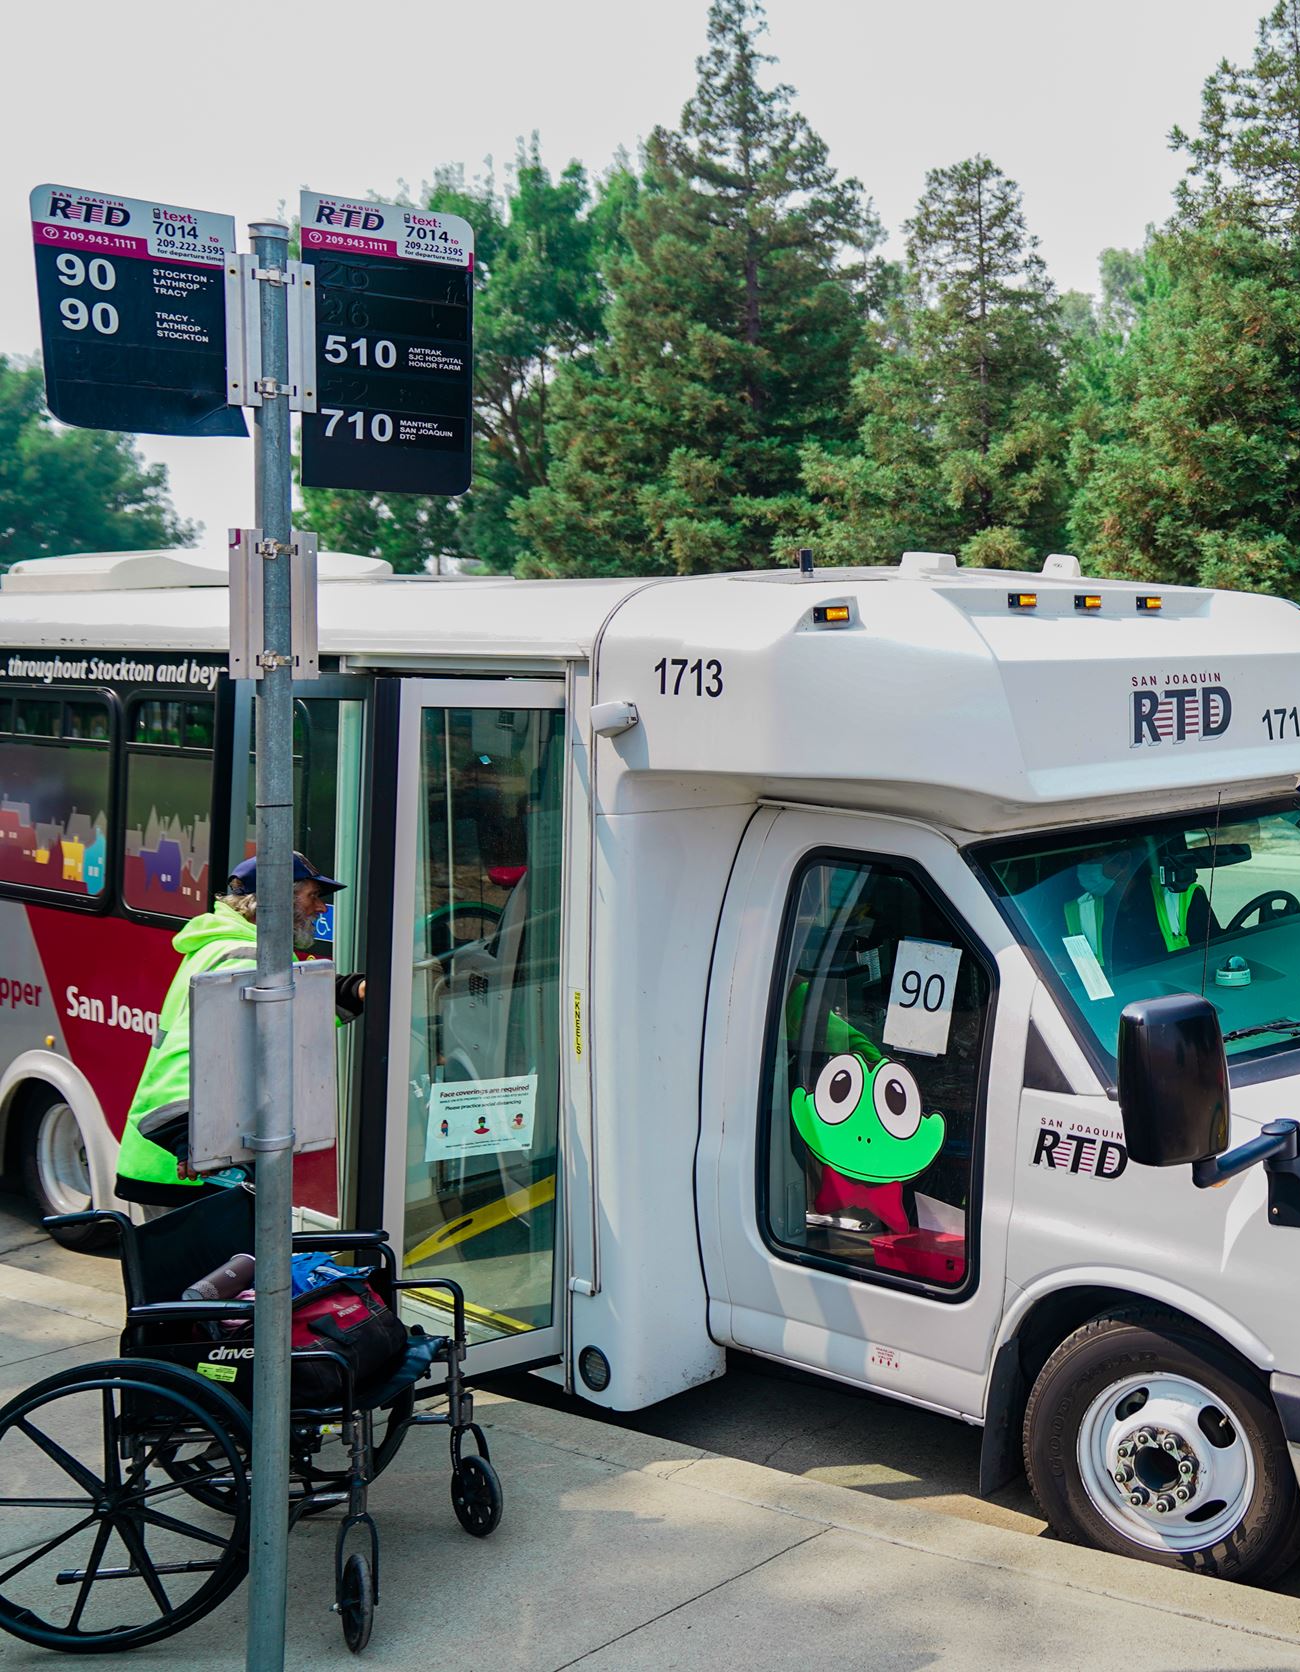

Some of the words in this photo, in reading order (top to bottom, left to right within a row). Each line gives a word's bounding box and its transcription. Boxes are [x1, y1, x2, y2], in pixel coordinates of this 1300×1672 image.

[51, 190, 73, 199] SAN
[79, 195, 125, 208] JOAQUIN
[318, 199, 337, 207] SAN
[341, 203, 380, 213] JOAQUIN
[48, 196, 131, 227] RTD
[163, 209, 198, 225] text:
[314, 204, 384, 231] RTD
[411, 214, 442, 228] text:
[63, 230, 137, 250] 209.943.1111
[152, 220, 199, 240] 7014
[209, 235, 220, 244] to
[405, 225, 449, 243] 7014
[156, 238, 225, 256] 209.222.3595
[325, 234, 388, 252] 209.943.1111
[404, 240, 463, 256] 209.222.3595
[169, 250, 206, 261] departure
[404, 249, 415, 257] for
[415, 250, 447, 261] departure
[447, 255, 463, 263] times
[56, 253, 116, 291] 90
[152, 268, 208, 283] STOCKTON
[153, 278, 200, 291] LATHROP
[153, 286, 188, 298] TRACY
[59, 297, 119, 335] 90
[155, 311, 189, 322] TRACY
[156, 321, 201, 333] LATHROP
[156, 330, 209, 343] STOCKTON
[325, 335, 397, 369] 510
[408, 347, 442, 356] AMTRAK
[408, 353, 424, 361] SJC
[425, 355, 463, 365] HOSPITAL
[408, 360, 438, 369] HONOR
[438, 363, 461, 371] FARM
[320, 408, 394, 443] 710
[400, 420, 438, 429] MANTHEY
[400, 426, 416, 434] SAN
[418, 428, 453, 437] JOAQUIN
[8, 654, 87, 683] throughout
[88, 657, 153, 682] Stockton
[156, 658, 188, 683] and
[189, 659, 229, 690] bey
[654, 657, 724, 698] 1713
[1131, 675, 1158, 688] SAN
[1164, 672, 1222, 685] JOAQUIN
[1129, 686, 1232, 749] RTD
[0, 977, 42, 1009] pper
[899, 970, 945, 1013] 90
[66, 985, 105, 1024] San
[107, 995, 161, 1043] Joaq
[574, 1001, 582, 1055] KNEELS
[440, 1090, 455, 1098] Face
[455, 1088, 488, 1097] coverings
[500, 1084, 530, 1094] required
[1040, 1117, 1063, 1129] SAN
[1069, 1123, 1123, 1140] JOAQUIN
[1029, 1128, 1128, 1181] RTD
[208, 1346, 255, 1360] drive
